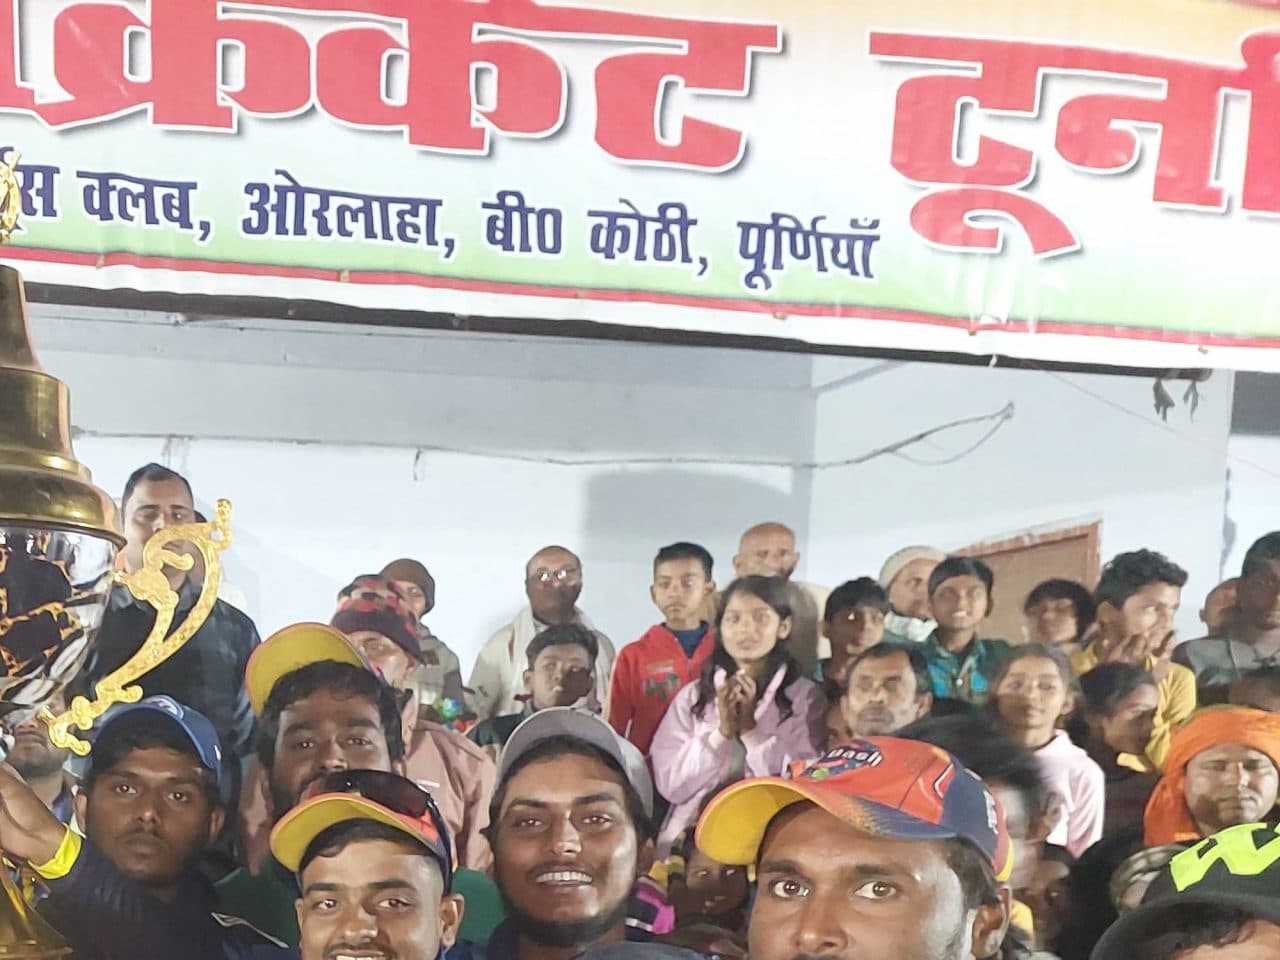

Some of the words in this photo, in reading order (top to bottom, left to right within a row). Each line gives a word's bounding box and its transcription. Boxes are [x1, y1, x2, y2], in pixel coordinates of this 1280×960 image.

[76, 170, 211, 241] क्लब,
[242, 169, 456, 258] ओरलाहा,
[587, 197, 708, 275] कोठी,
